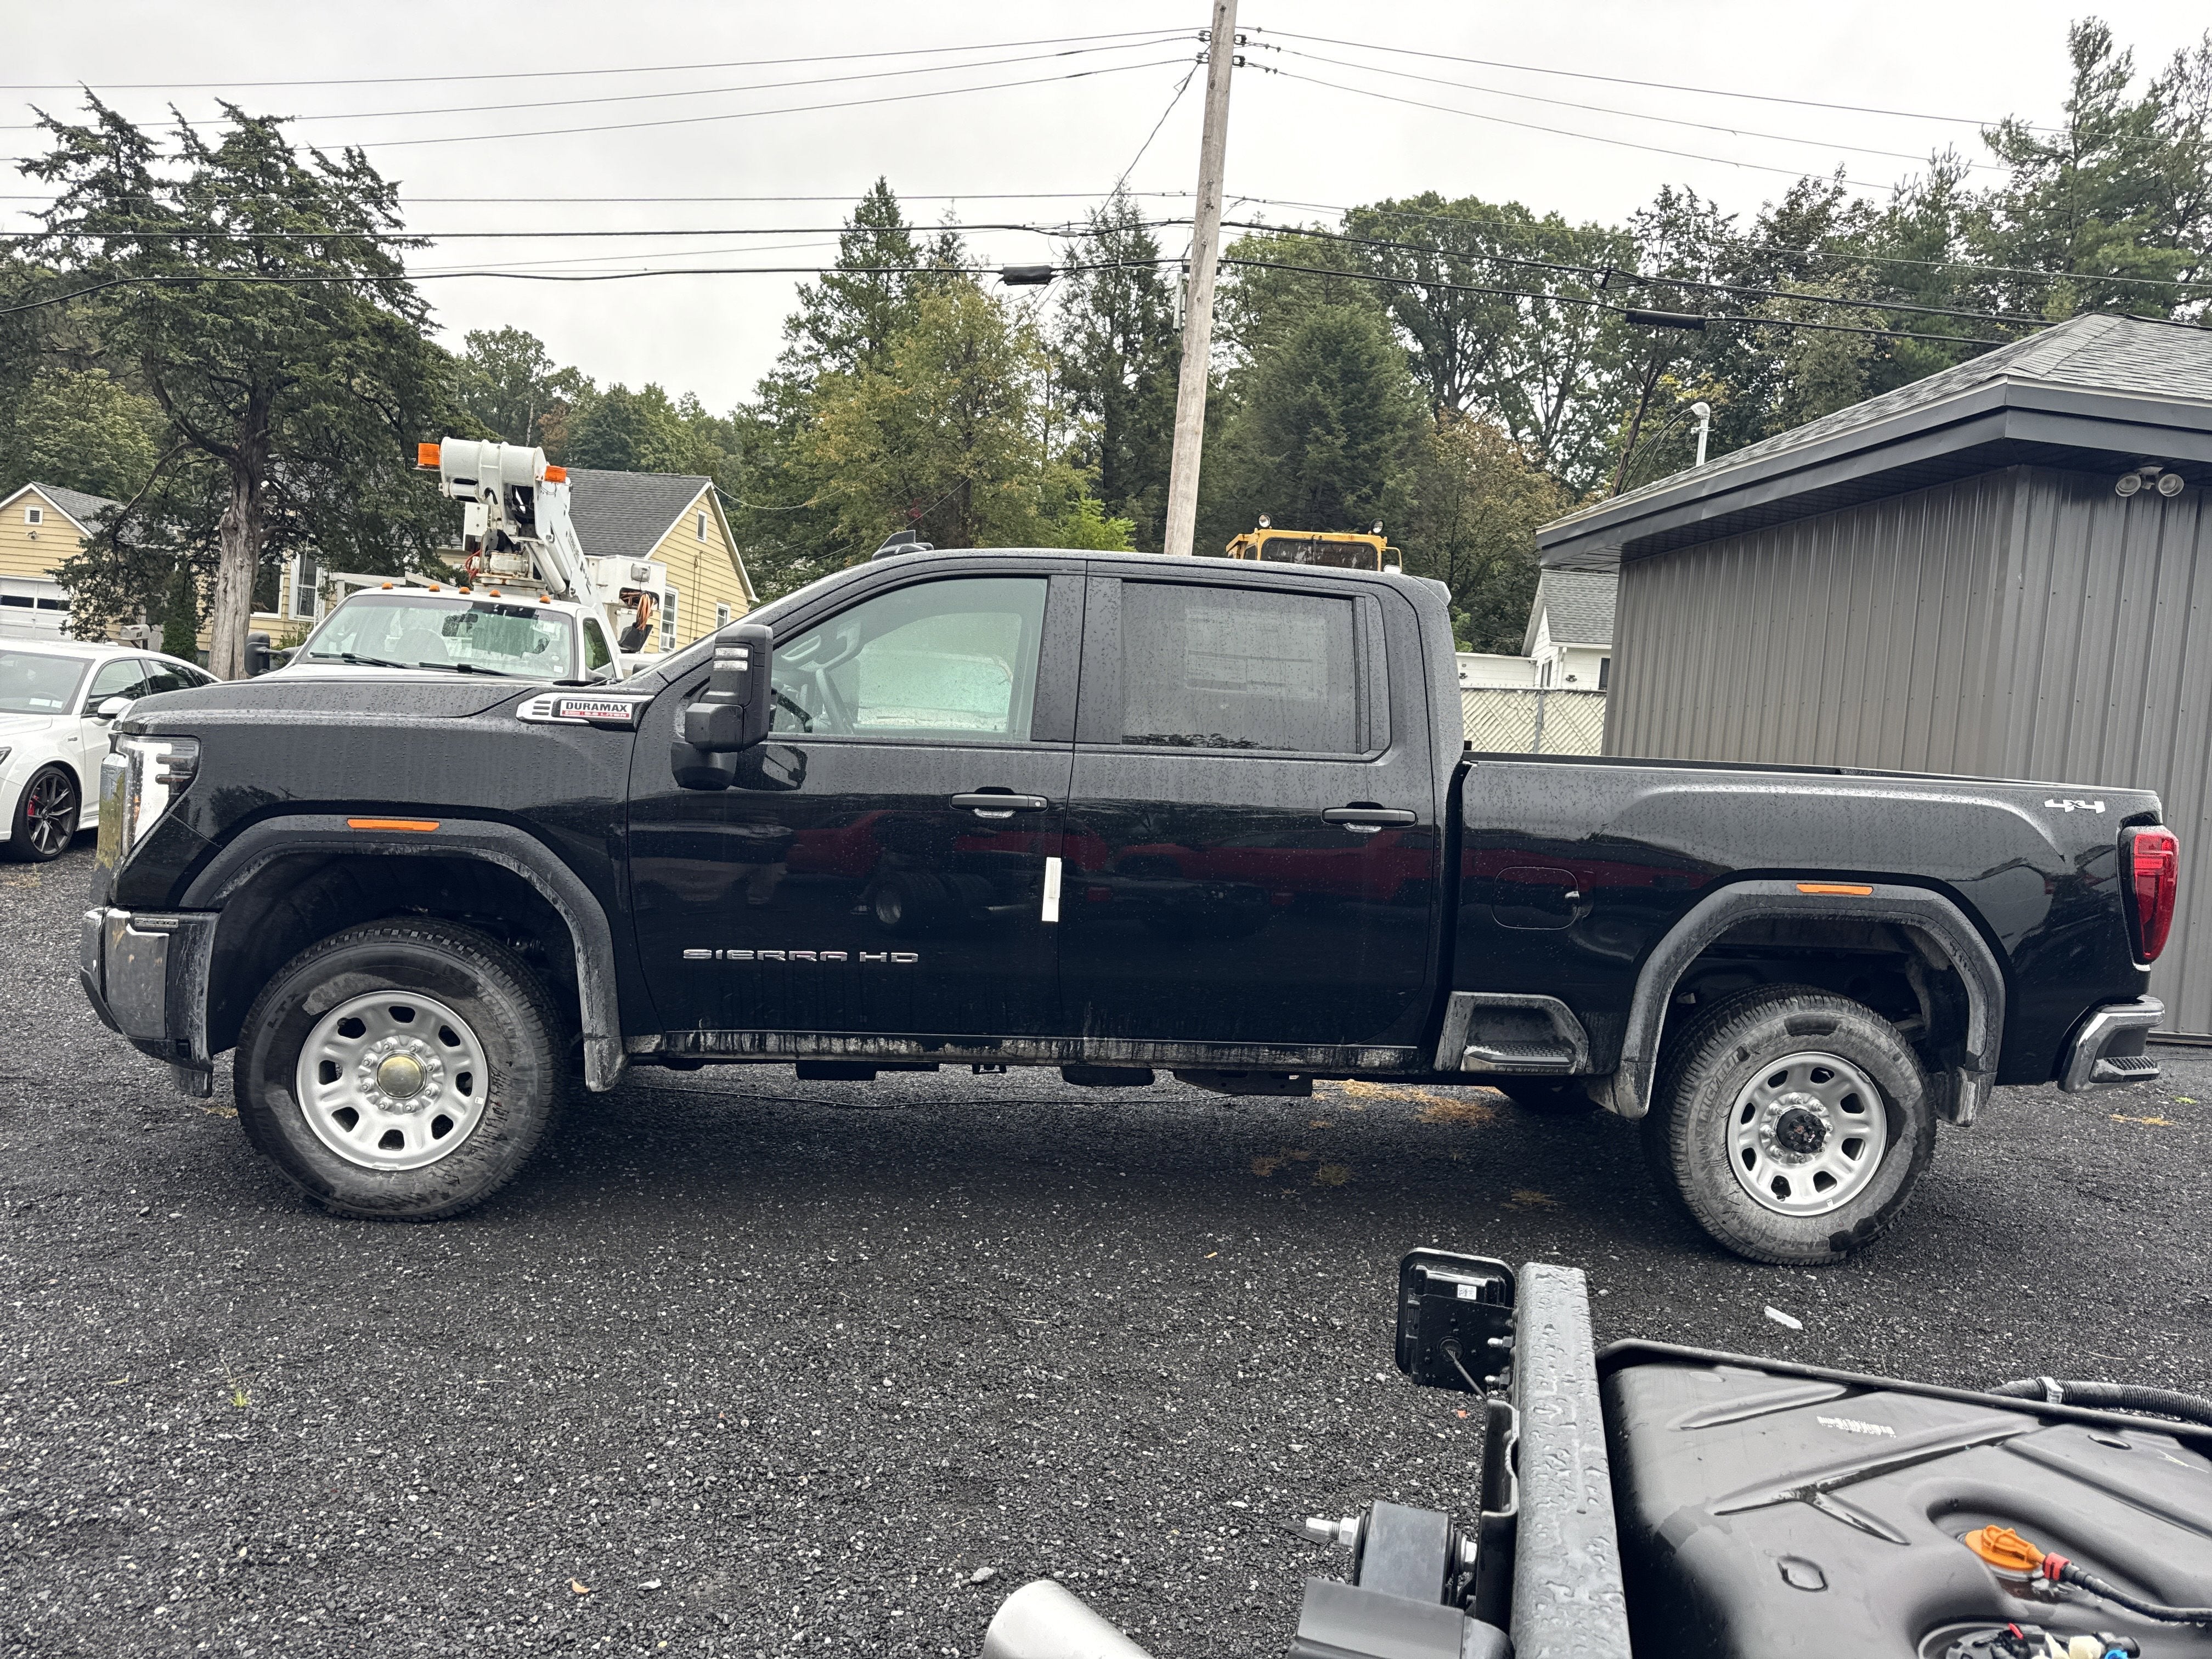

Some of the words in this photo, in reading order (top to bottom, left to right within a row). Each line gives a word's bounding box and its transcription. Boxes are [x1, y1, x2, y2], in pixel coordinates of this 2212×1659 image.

[566, 702, 628, 712] DURAMAX
[683, 949, 848, 962] SIERRA
[860, 952, 918, 963] HD
